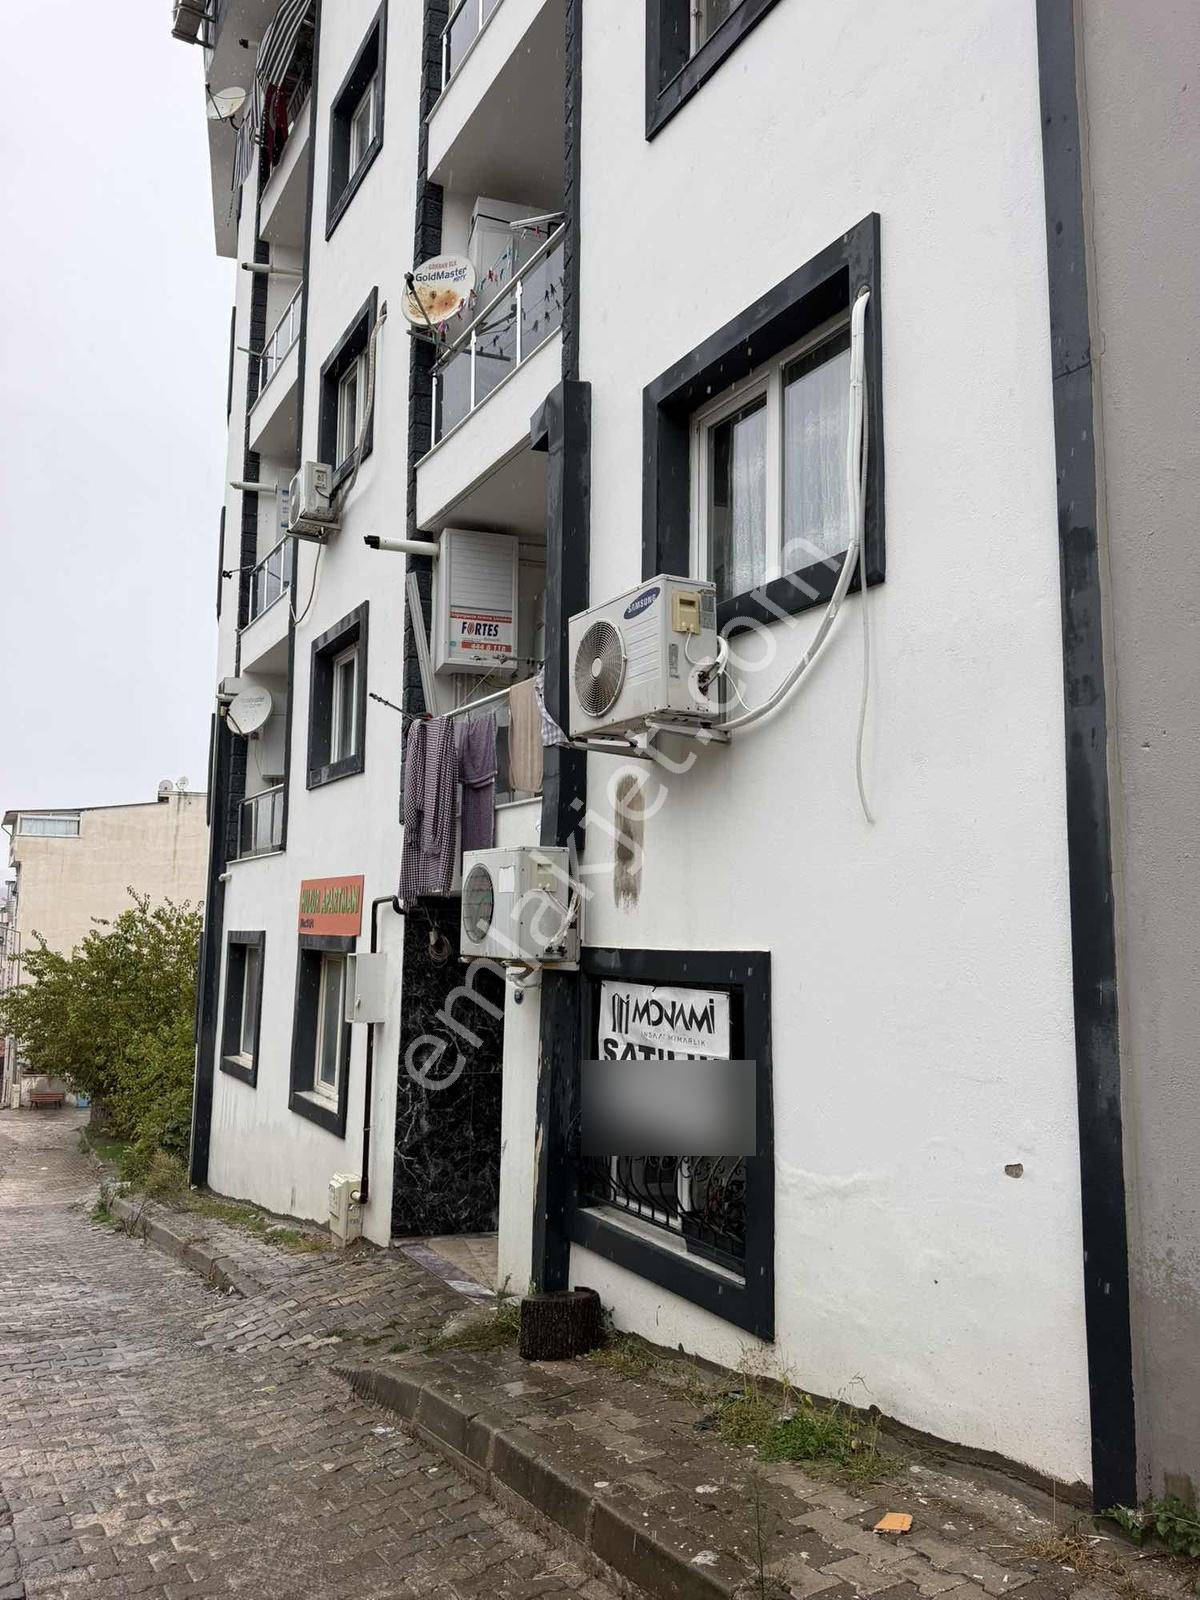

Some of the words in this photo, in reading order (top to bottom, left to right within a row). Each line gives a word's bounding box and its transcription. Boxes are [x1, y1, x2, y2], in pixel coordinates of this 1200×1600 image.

[415, 267, 467, 282] GoldMaster
[627, 593, 657, 614] SAMSUNG
[461, 621, 499, 637] FORTES
